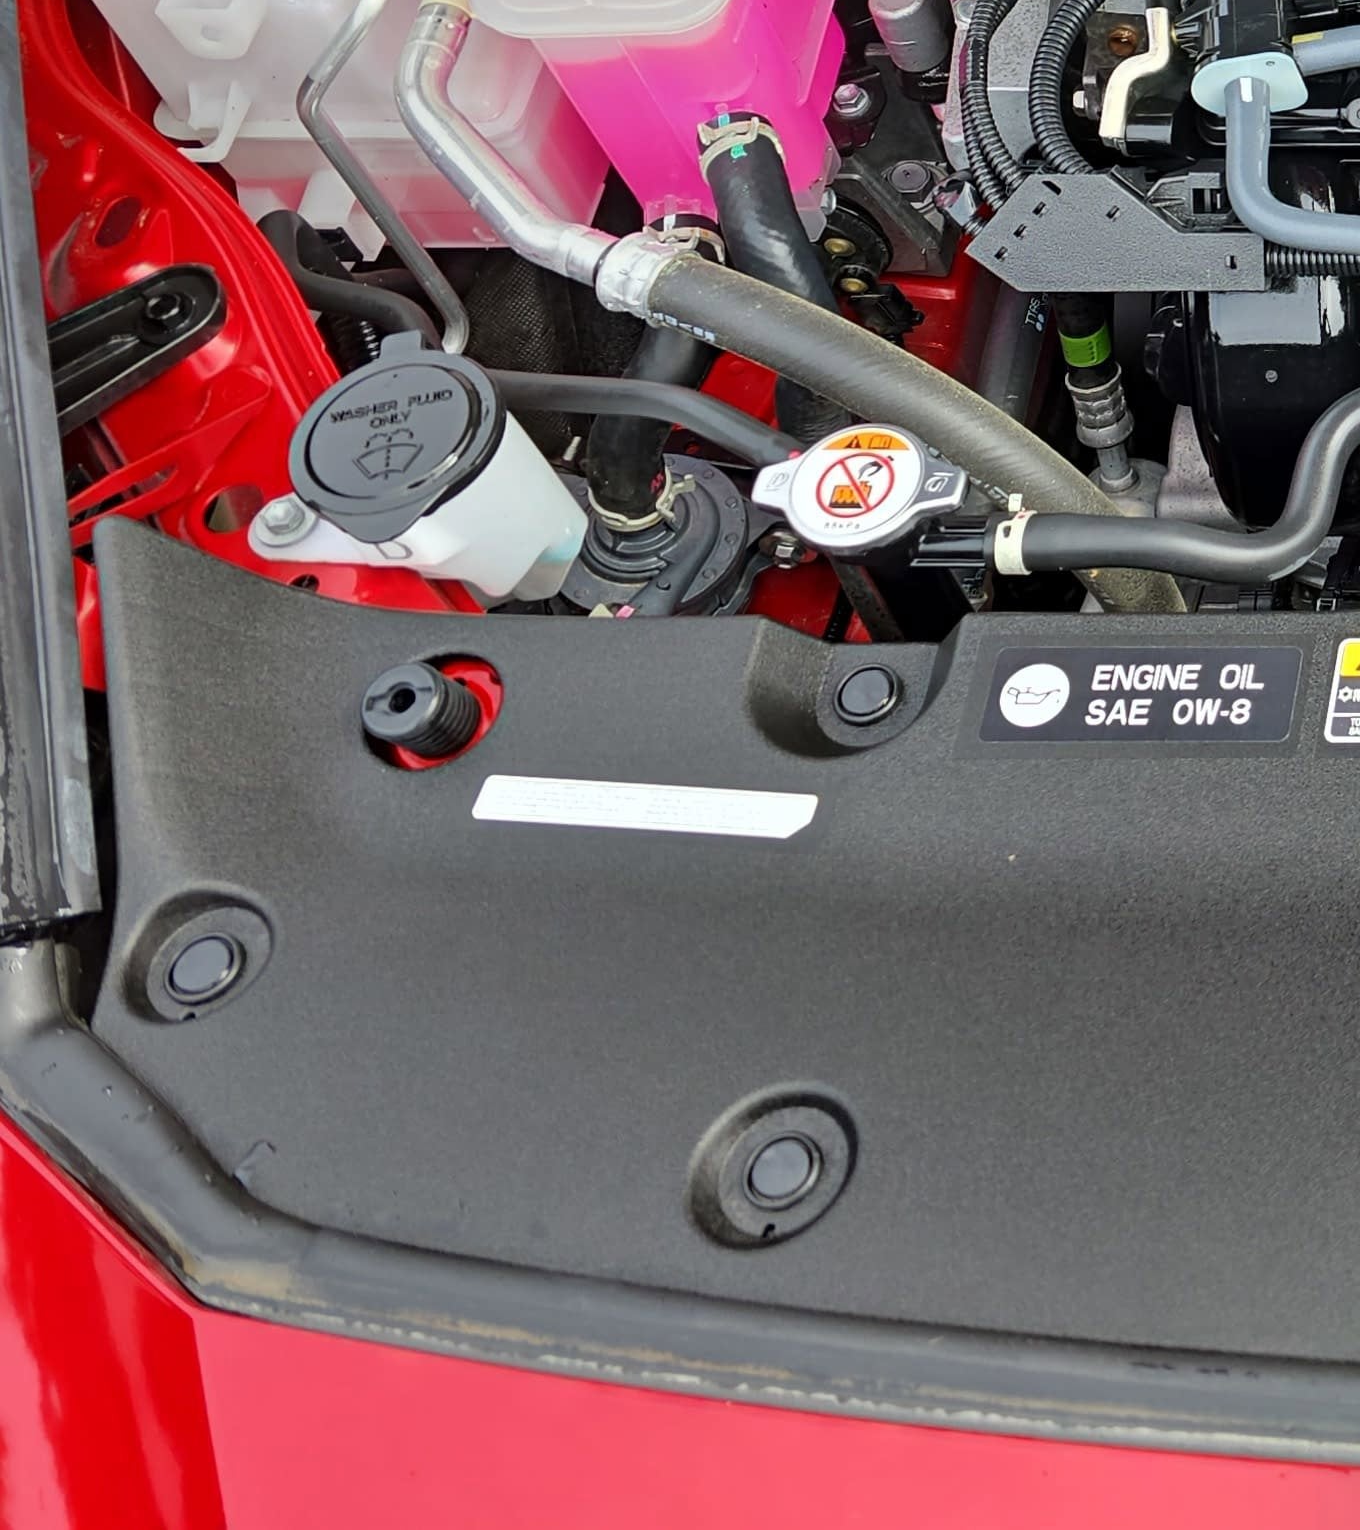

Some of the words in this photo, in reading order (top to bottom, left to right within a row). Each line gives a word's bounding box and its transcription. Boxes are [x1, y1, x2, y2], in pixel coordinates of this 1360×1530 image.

[330, 400, 398, 424] WASHER
[408, 389, 453, 407] FLUID
[370, 410, 411, 429] ONLY
[1091, 664, 1202, 691] ENGINE
[1219, 663, 1265, 691] OIL
[1085, 699, 1152, 726] SAE
[1172, 698, 1251, 725] 0W-8
